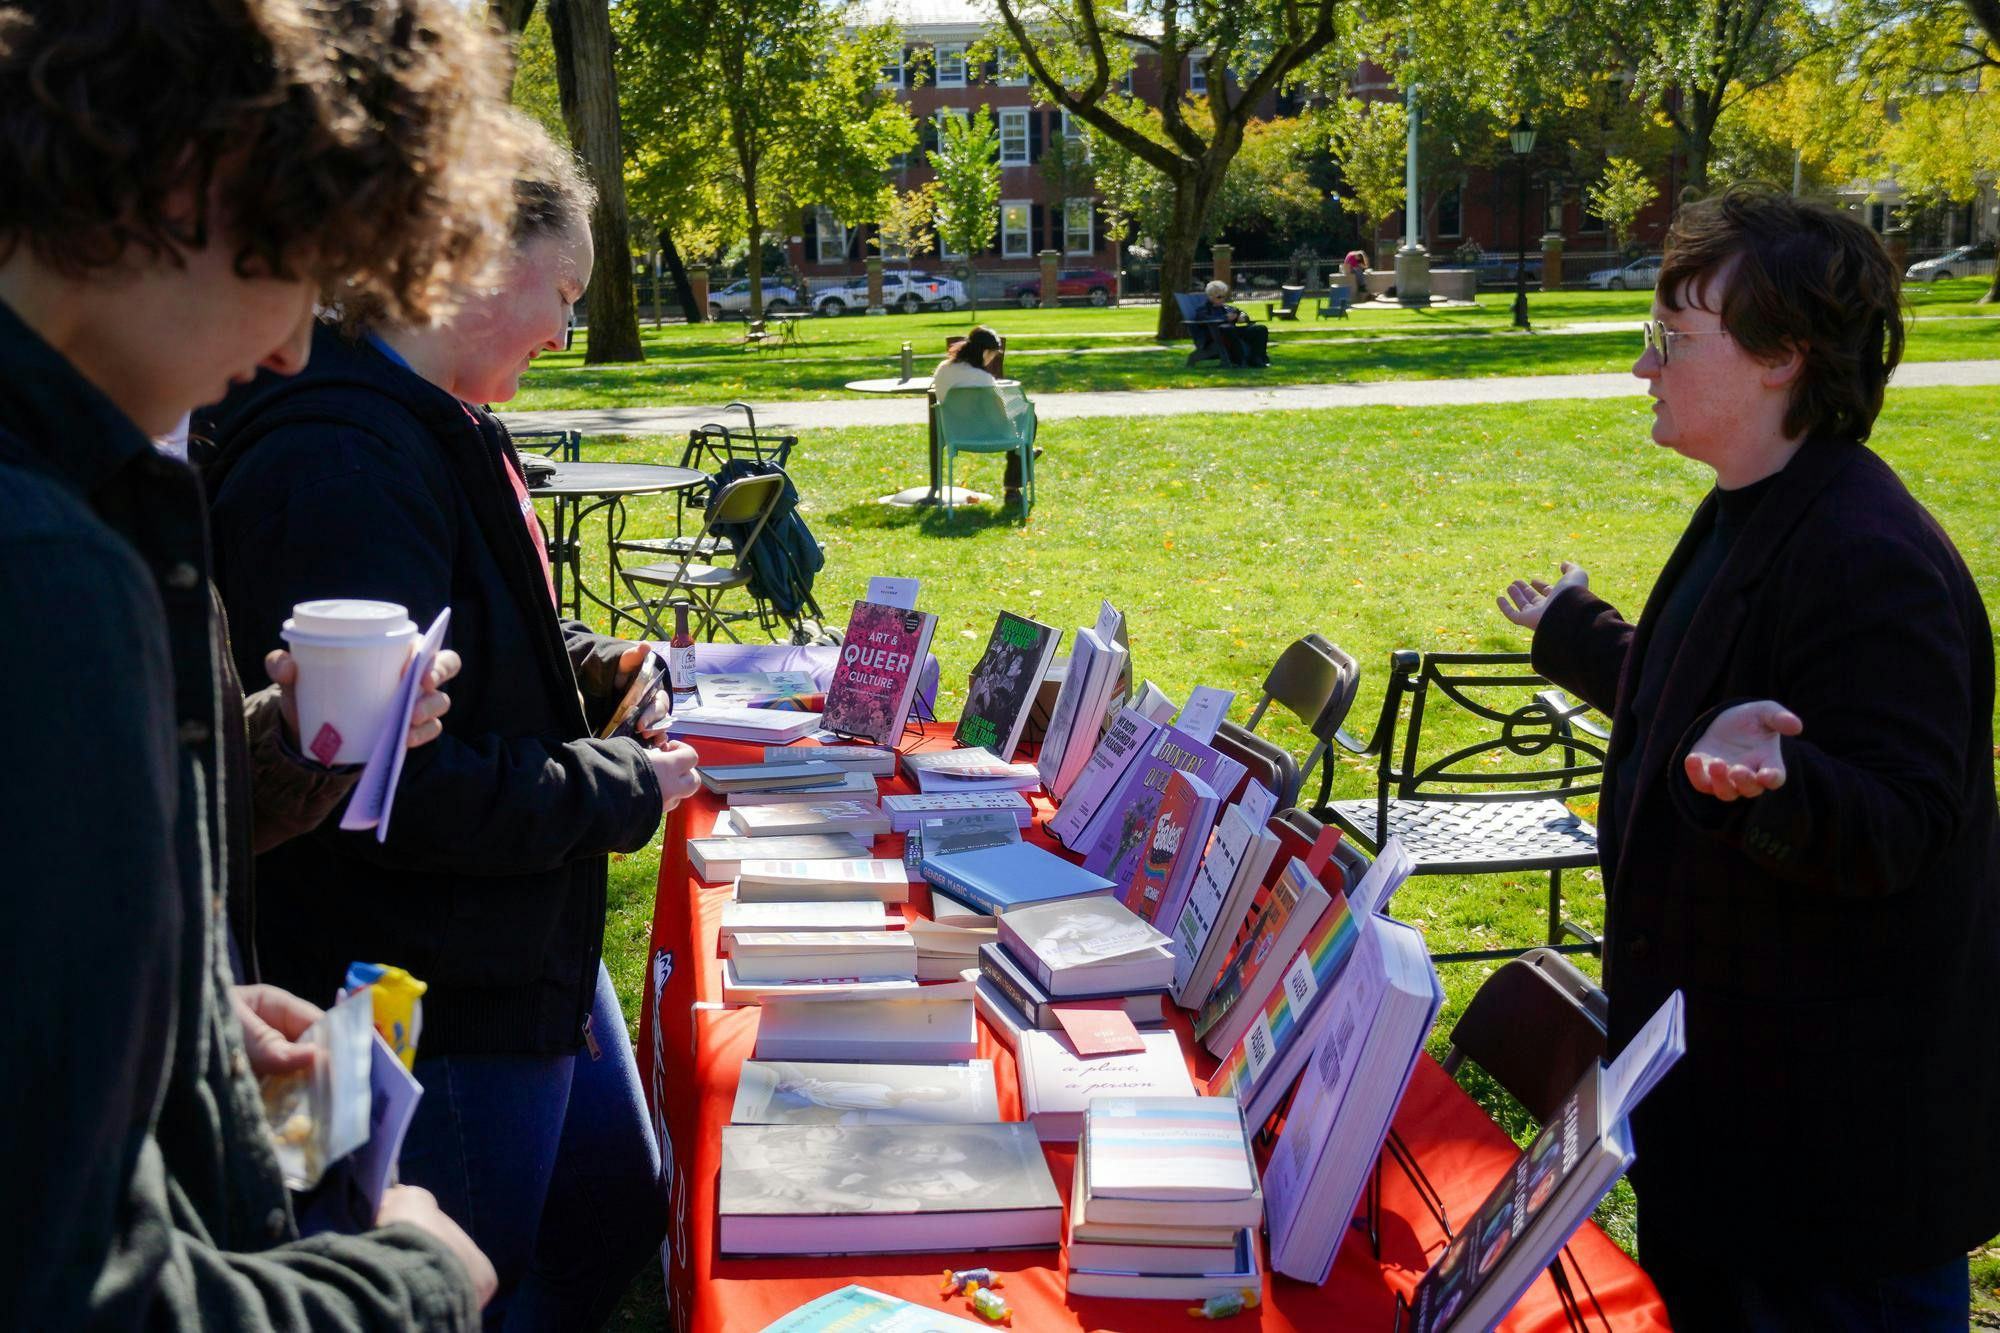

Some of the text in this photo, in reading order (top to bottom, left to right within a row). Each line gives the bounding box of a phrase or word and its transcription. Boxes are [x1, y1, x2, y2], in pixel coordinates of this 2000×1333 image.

[868, 631, 898, 646] ART &
[844, 644, 910, 673] QUEER
[849, 671, 894, 689] CULTURE
[1109, 725, 1137, 750] LAUGHED IN
[1122, 719, 1138, 736] BOTH
[1102, 734, 1126, 758] PLEASURE
[1157, 742, 1206, 774] OUNTRY
[923, 866, 968, 897] GENDER MAGIC
[1292, 968, 1308, 1003] QUEER
[1251, 1025, 1267, 1067] DESIGN
[1081, 1082, 1155, 1095] person
[1515, 1155, 1529, 1191] LADY
